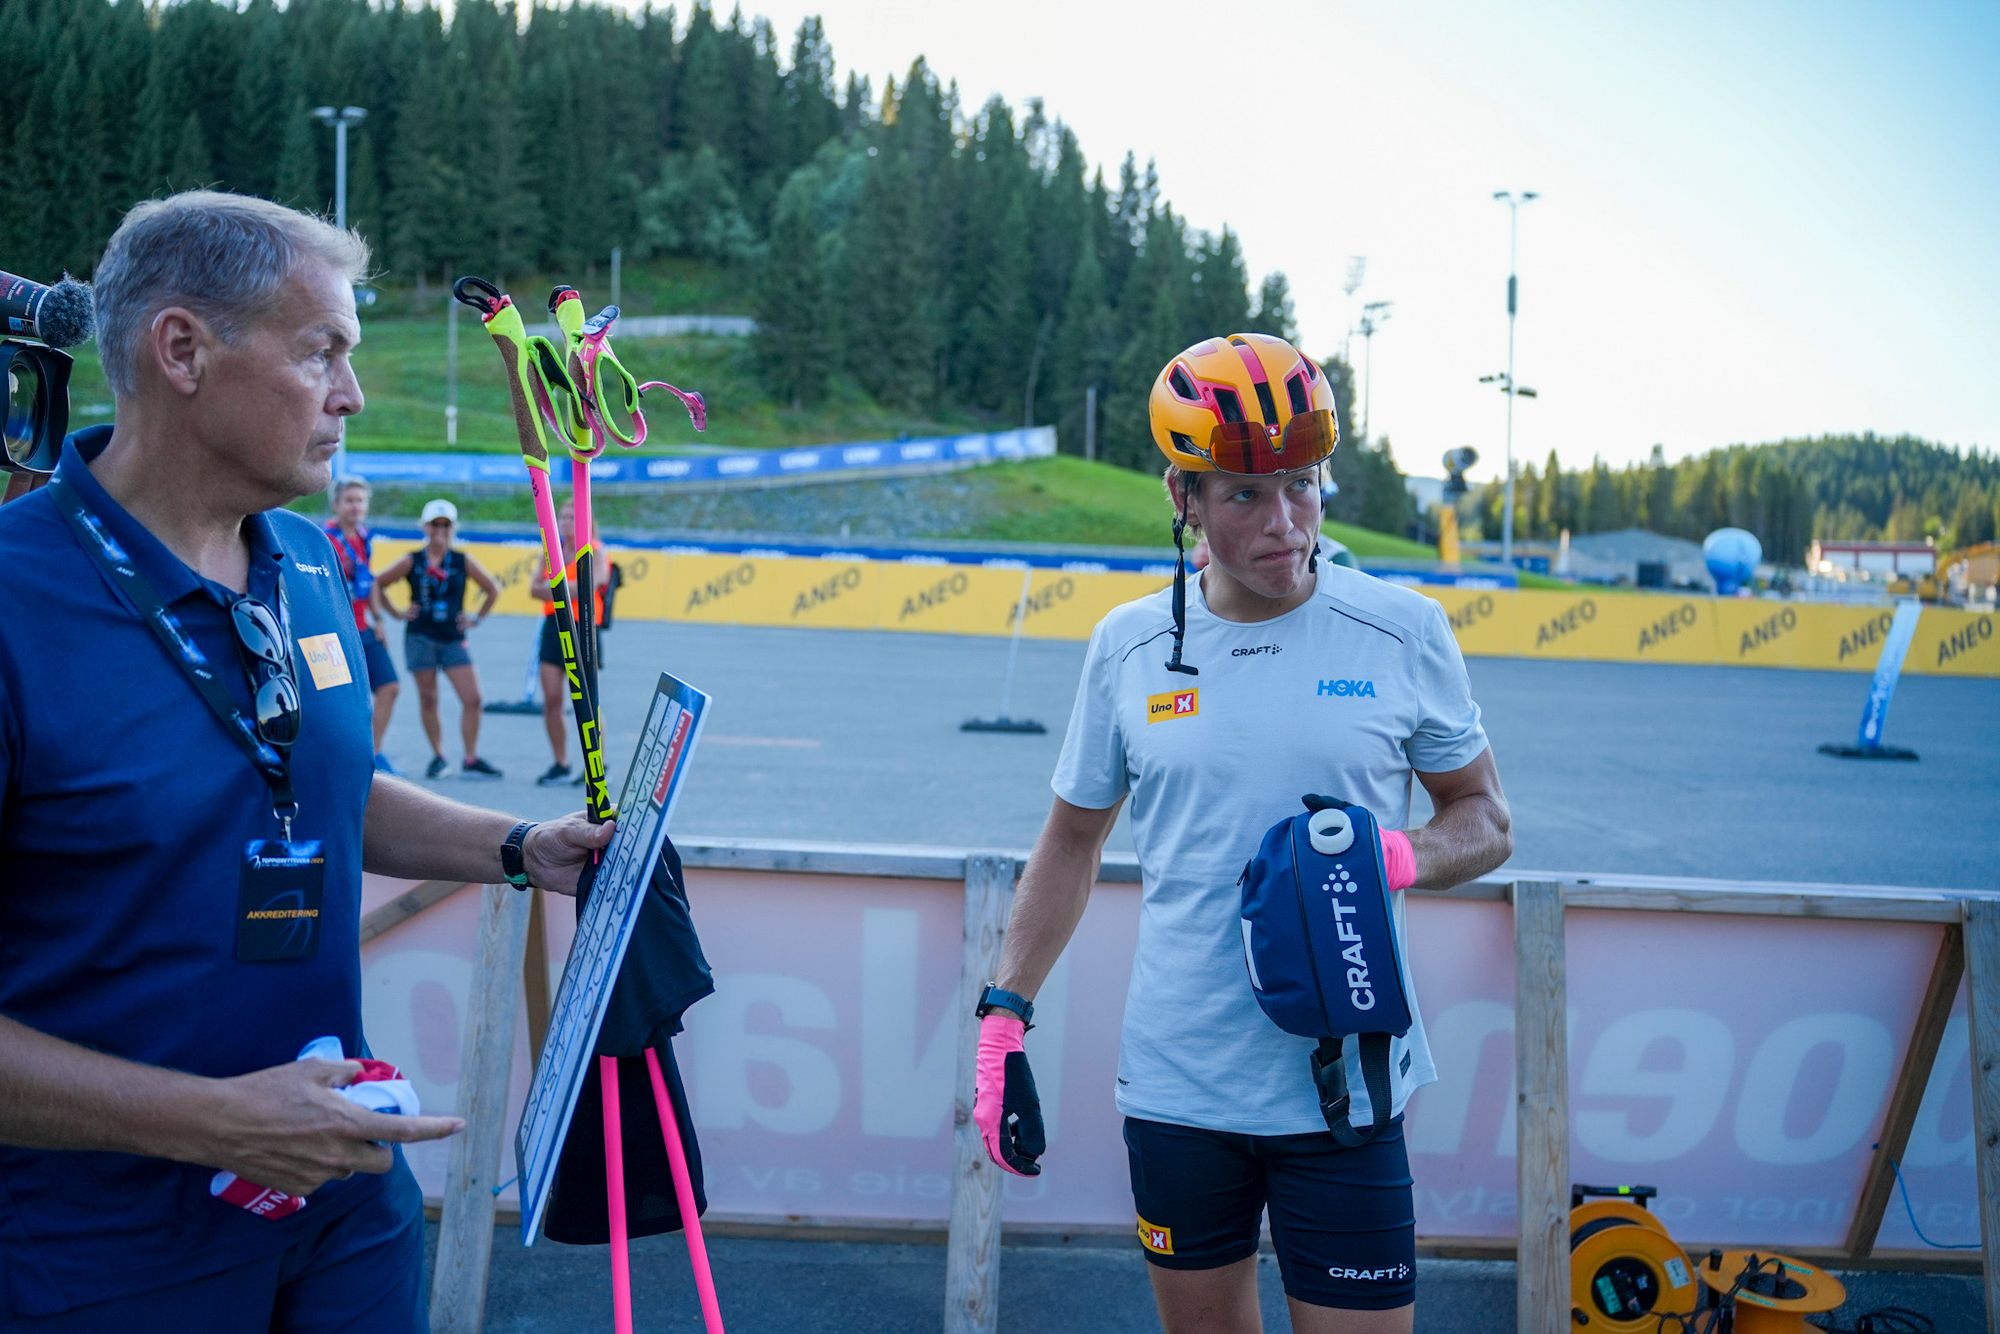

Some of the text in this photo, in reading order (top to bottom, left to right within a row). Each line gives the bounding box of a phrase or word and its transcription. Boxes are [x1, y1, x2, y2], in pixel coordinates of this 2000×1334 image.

[296, 562, 323, 575] CRAFT
[685, 562, 755, 614] ANEO
[791, 566, 860, 619] ANEO
[899, 571, 968, 622] ANEO
[1007, 577, 1074, 627] ANEO
[1448, 595, 1494, 630] NEO
[1536, 598, 1597, 649] ANEO
[1637, 602, 1697, 654] ANEO
[1739, 607, 1797, 657] ANEO
[1838, 612, 1894, 662] ANEO
[1938, 615, 1993, 667] ANEO
[1231, 646, 1271, 657] CRAFT
[1150, 694, 1192, 714] Uno X
[1317, 679, 1376, 698] HOKA
[582, 720, 613, 818] LEKI
[655, 715, 686, 796] BN Bank
[605, 724, 668, 904] JOHANNES
[246, 910, 319, 920] AKKREDITERING
[1332, 898, 1375, 1011] CRAFT
[1152, 1231, 1165, 1249] X
[1328, 1267, 1397, 1280] CRAFT
